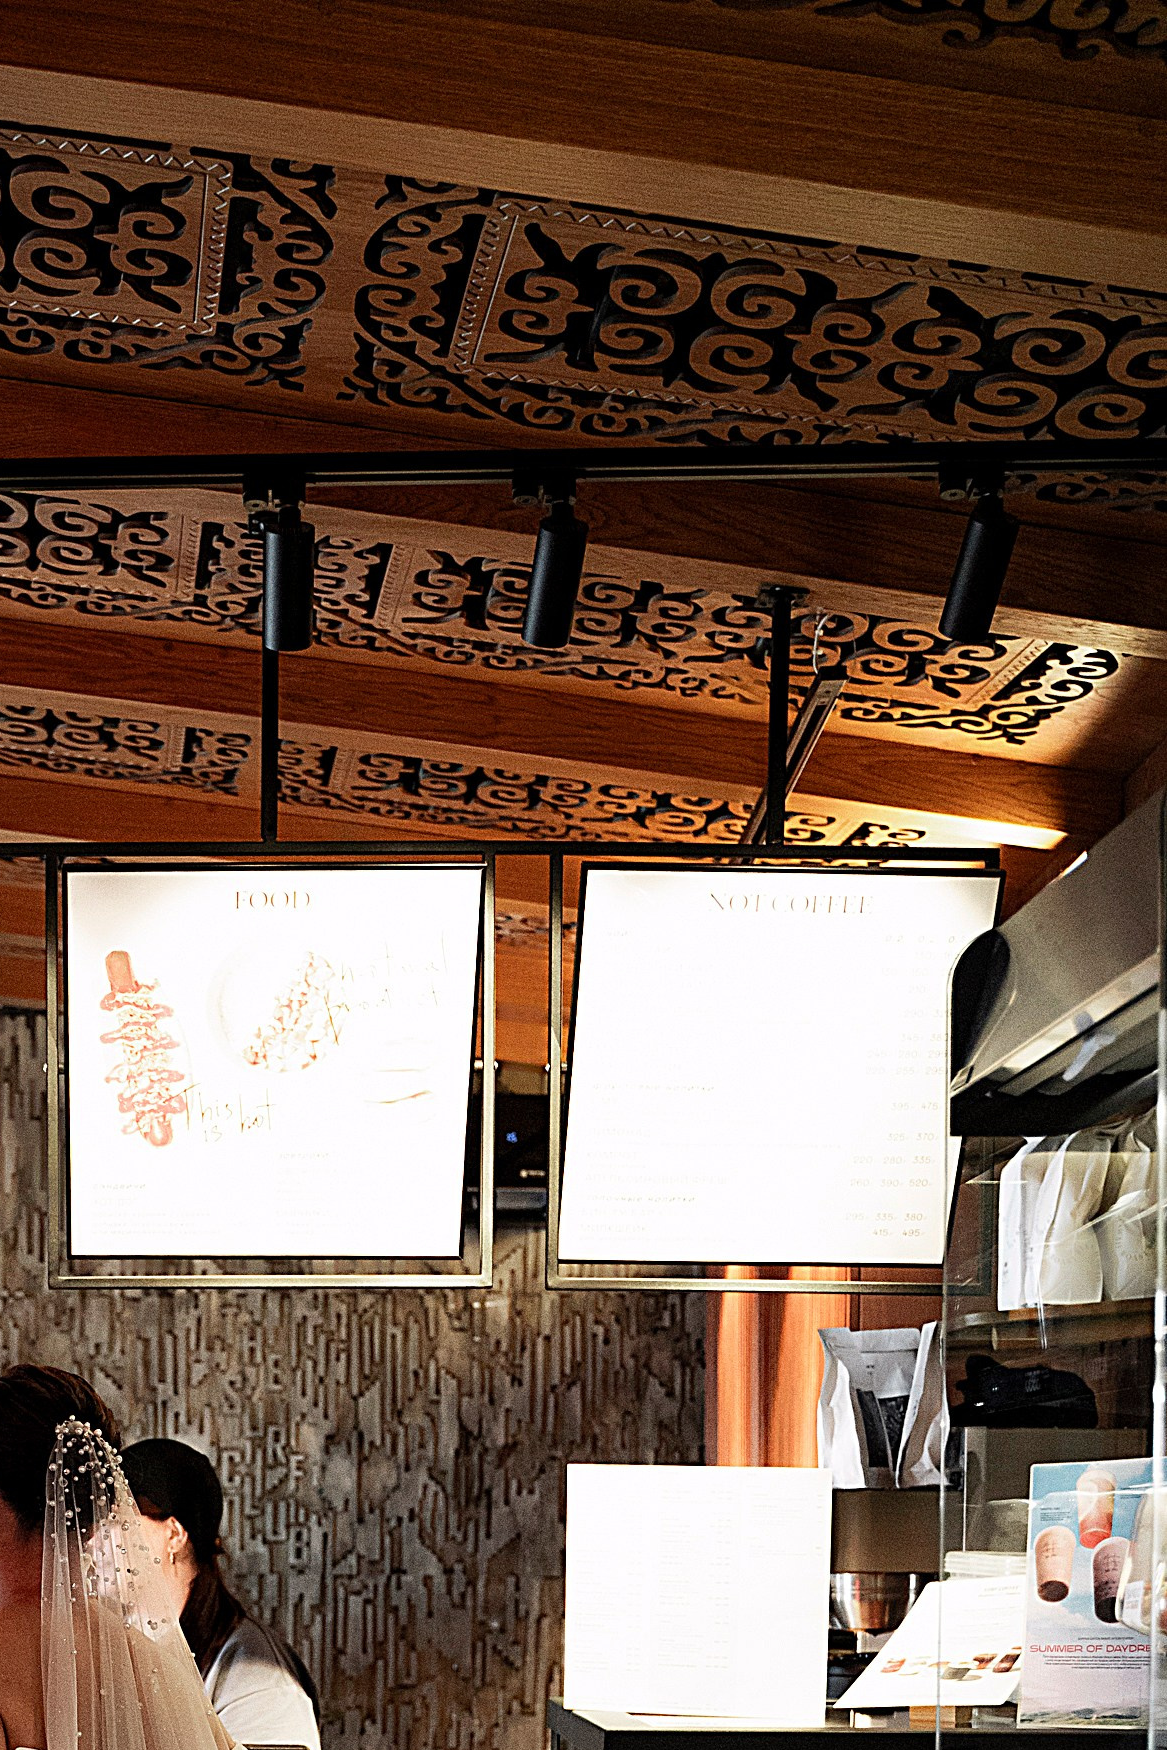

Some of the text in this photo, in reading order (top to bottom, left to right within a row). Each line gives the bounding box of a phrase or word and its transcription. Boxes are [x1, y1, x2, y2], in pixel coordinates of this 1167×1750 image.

[235, 890, 312, 910] FOOD
[1029, 1644, 1152, 1653] SUMMER OF DAYDRE
